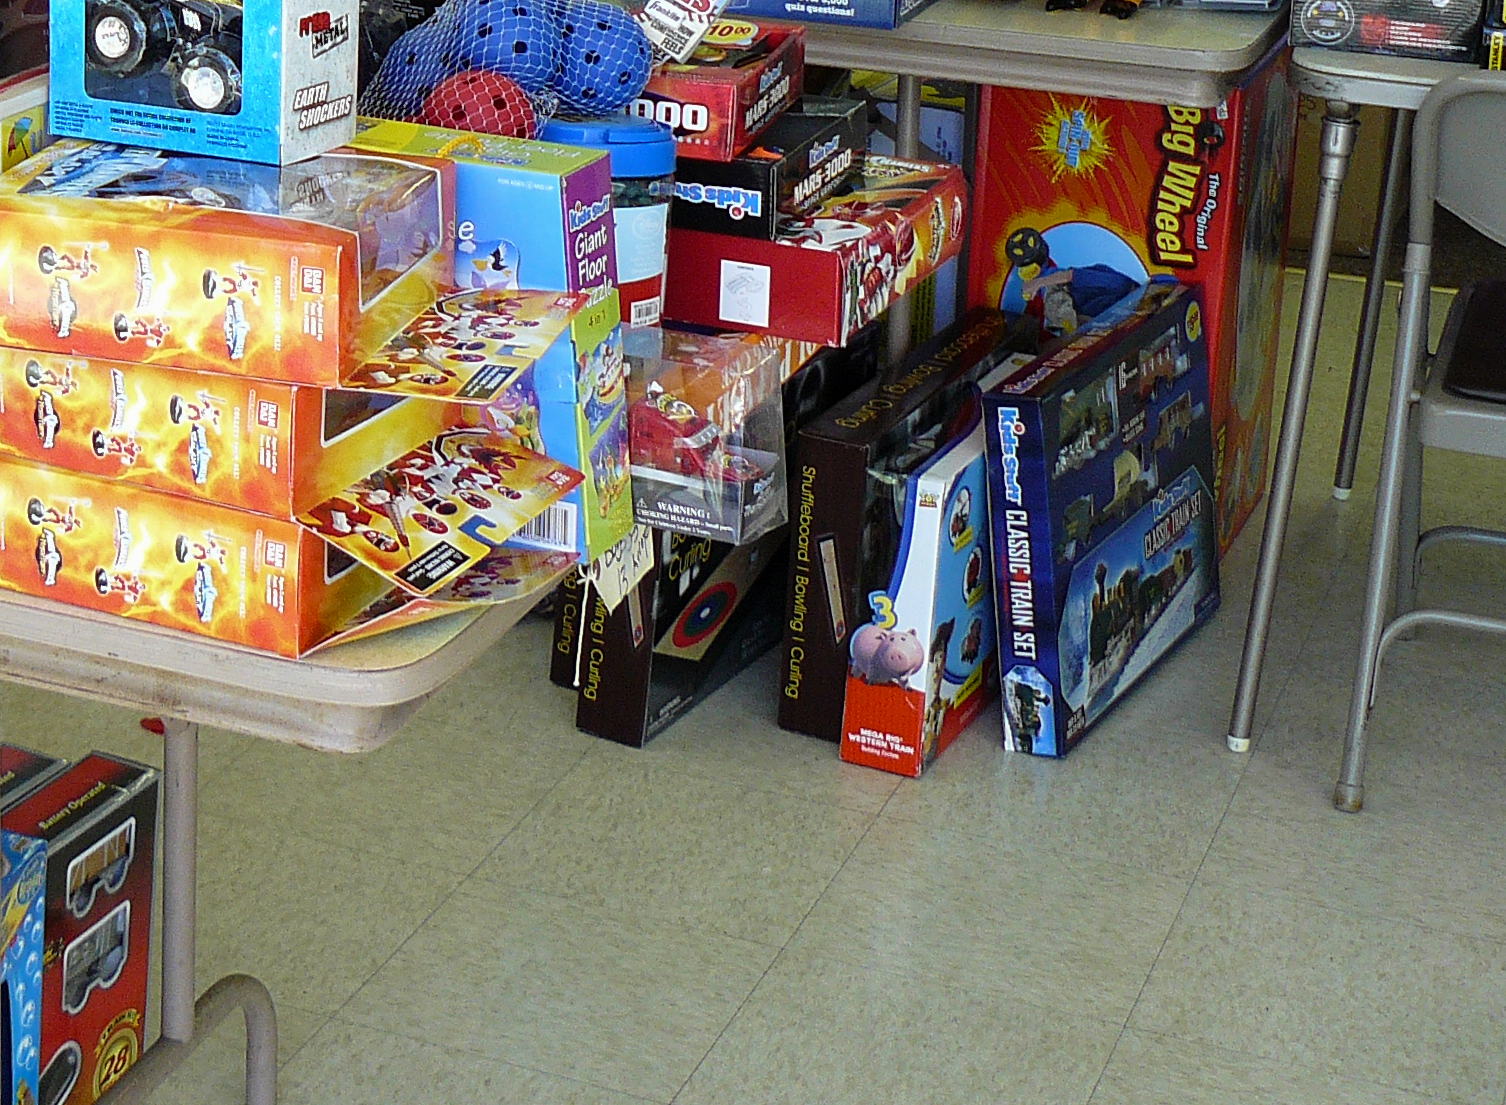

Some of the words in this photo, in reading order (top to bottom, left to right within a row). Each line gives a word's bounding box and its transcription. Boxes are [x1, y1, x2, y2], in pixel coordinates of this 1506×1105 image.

[647, 1, 682, 24] franklin
[314, 23, 347, 50] METAL
[294, 82, 329, 111] EARTH
[299, 95, 352, 131] SHOCKERS
[744, 73, 792, 131] MARS-3000
[1161, 105, 1202, 157] Big
[794, 147, 853, 207] MARS-3000
[1207, 173, 1221, 196] The
[1154, 159, 1202, 264] Wheel
[1195, 197, 1218, 250] Original
[574, 224, 608, 260] Giant
[578, 253, 609, 287] Floor
[258, 400, 268, 427] DAI
[267, 402, 278, 429] BAN
[997, 405, 1024, 460] Kids
[637, 509, 670, 522] CHOKING
[796, 465, 816, 563] Shuffleboard
[1143, 520, 1171, 561] CLASSIC
[1189, 489, 1203, 521] SET
[1005, 509, 1030, 576] CLASSIC
[789, 574, 810, 633] Bowling
[869, 591, 898, 630] 3
[1009, 572, 1035, 632] TRAIN
[558, 602, 578, 655] Curling
[1013, 631, 1038, 661] SET
[583, 647, 604, 701] Curling
[784, 646, 805, 699] Curling
[848, 732, 888, 748] WESTERN
[889, 741, 915, 755] TRAIN
[859, 727, 882, 740] MEGA
[37, 804, 71, 831] Battery
[68, 781, 107, 812] Operated
[100, 1047, 129, 1085] 28
